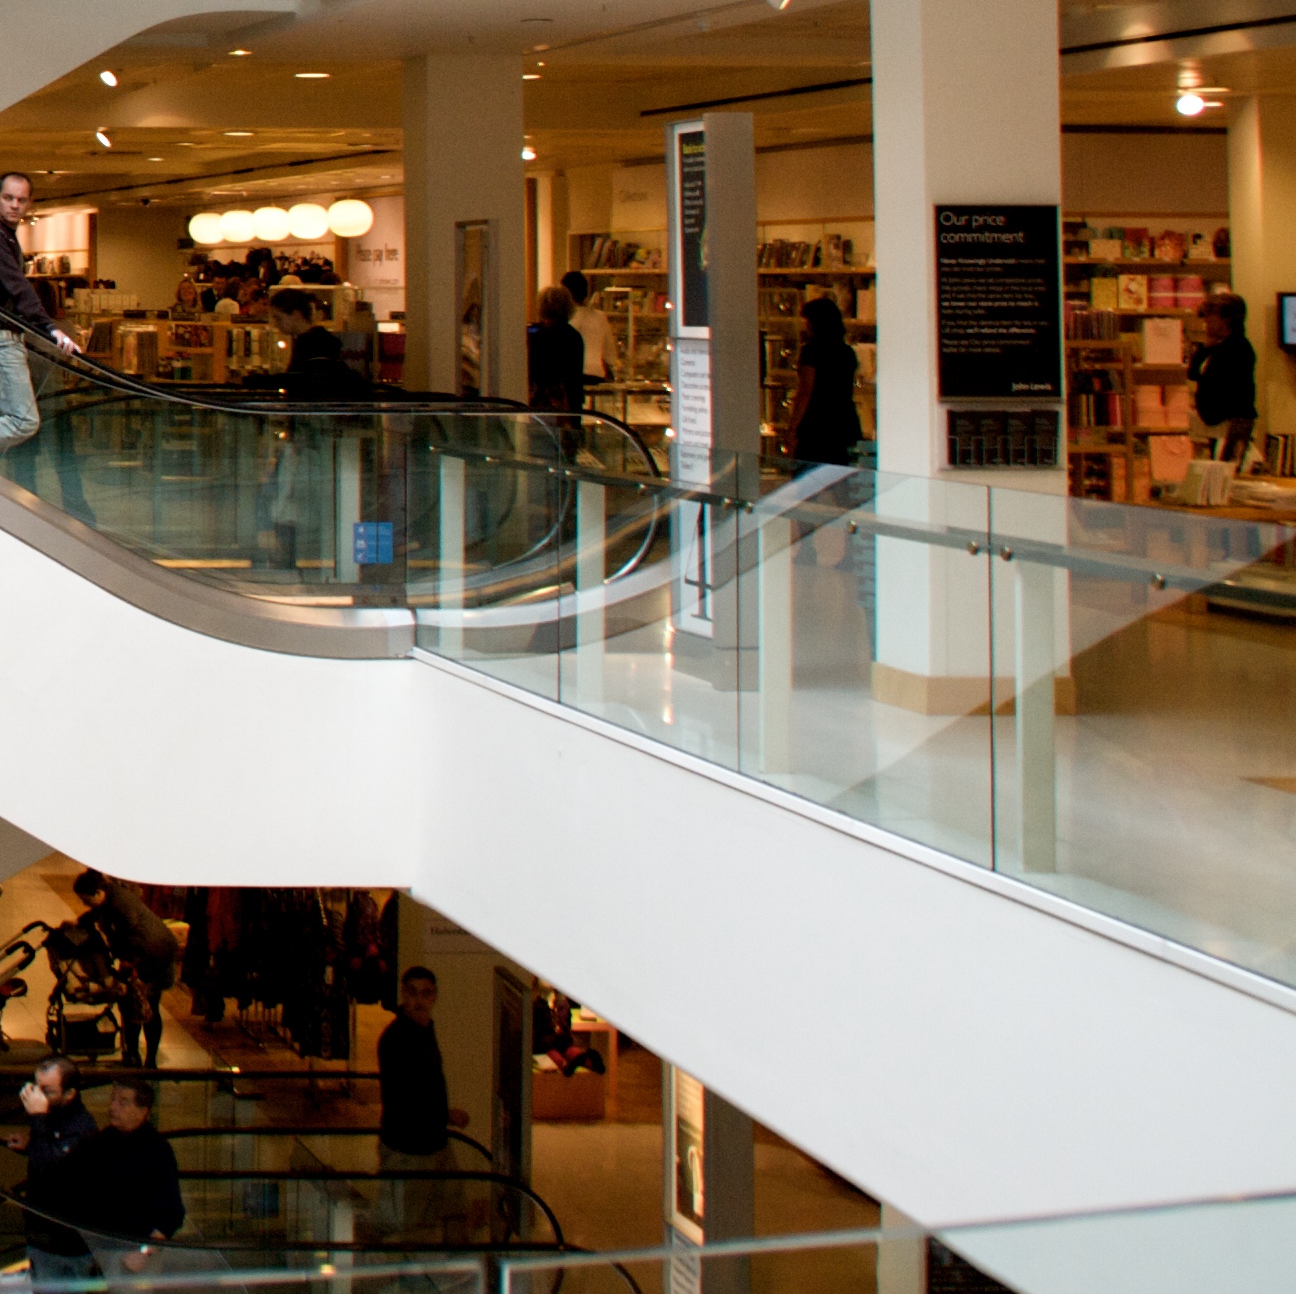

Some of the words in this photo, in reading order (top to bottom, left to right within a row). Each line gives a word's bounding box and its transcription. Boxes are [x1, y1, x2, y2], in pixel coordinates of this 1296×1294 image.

[940, 211, 968, 226] Our
[972, 214, 1005, 229] price
[940, 231, 1024, 243] commitment
